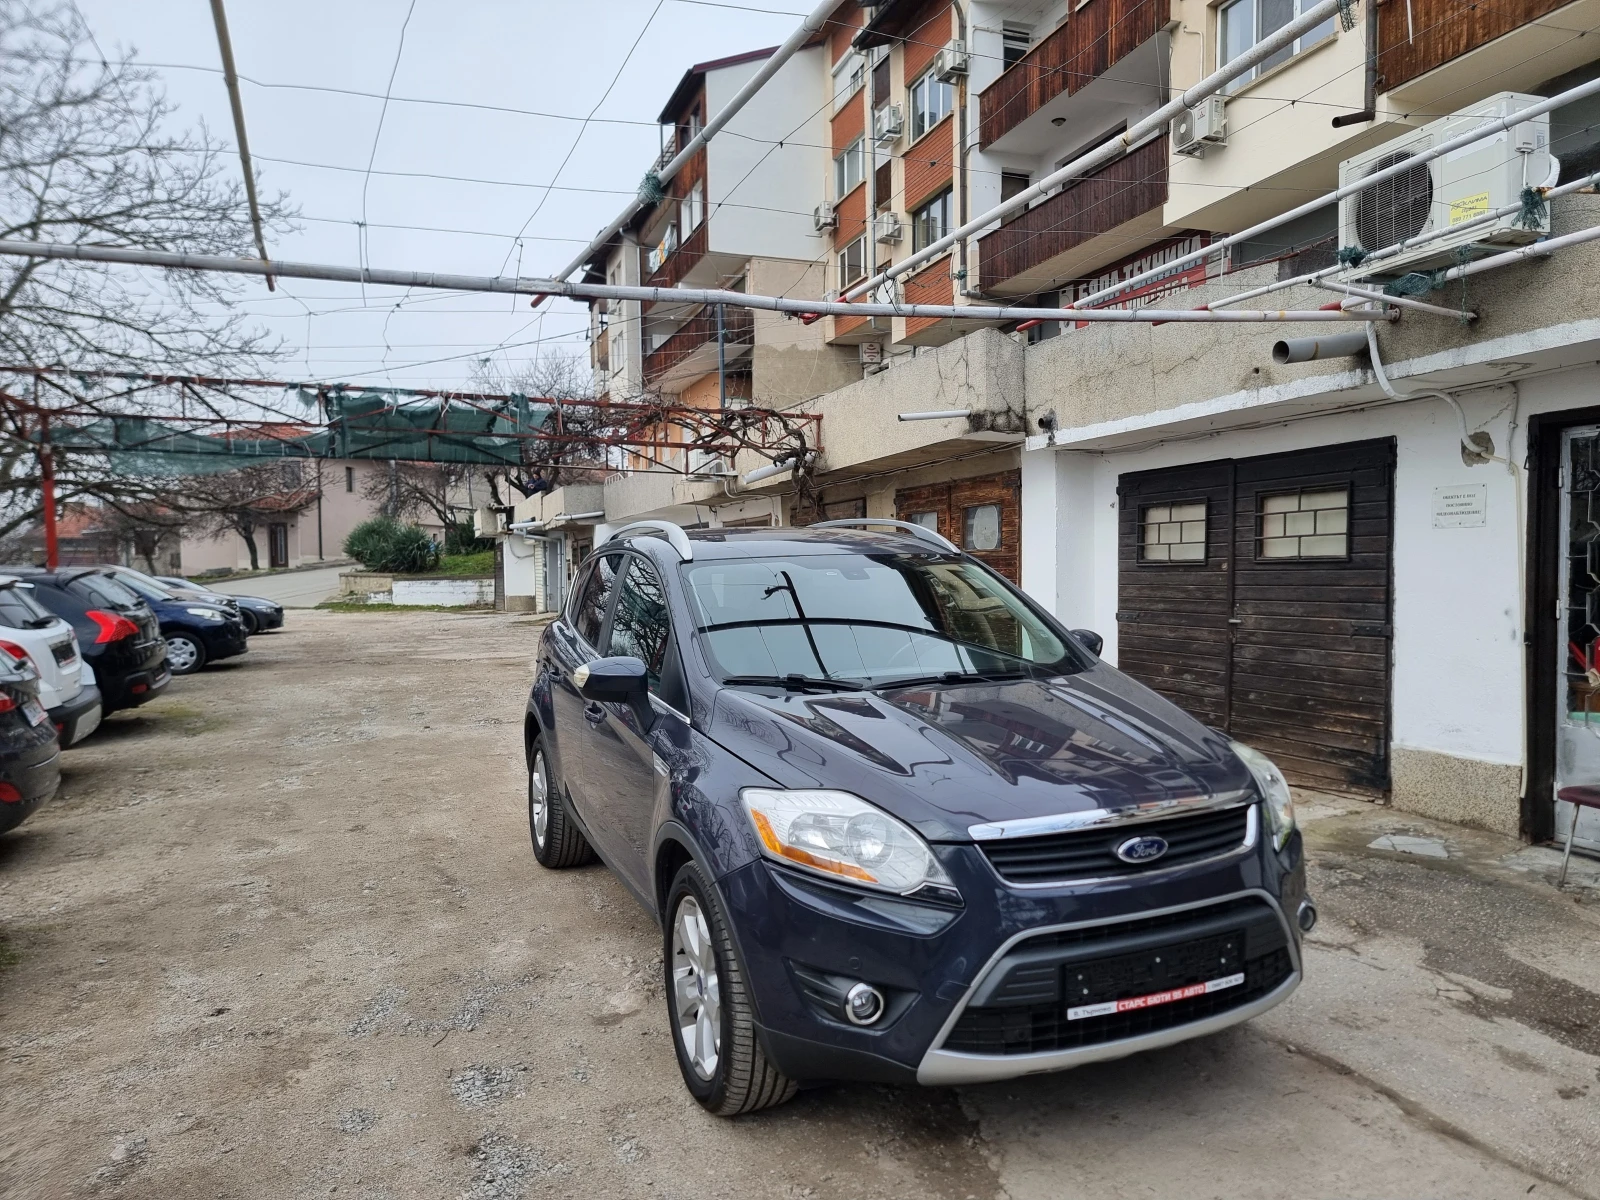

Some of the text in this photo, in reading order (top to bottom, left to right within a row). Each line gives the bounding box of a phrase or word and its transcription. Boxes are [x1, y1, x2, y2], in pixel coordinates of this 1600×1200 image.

[1131, 841, 1159, 858] Ford
[1118, 999, 1146, 1011] СТАРС
[1147, 993, 1171, 1006] БЮТИ
[1172, 991, 1183, 1002] 95
[1183, 985, 1205, 999] АВТО
